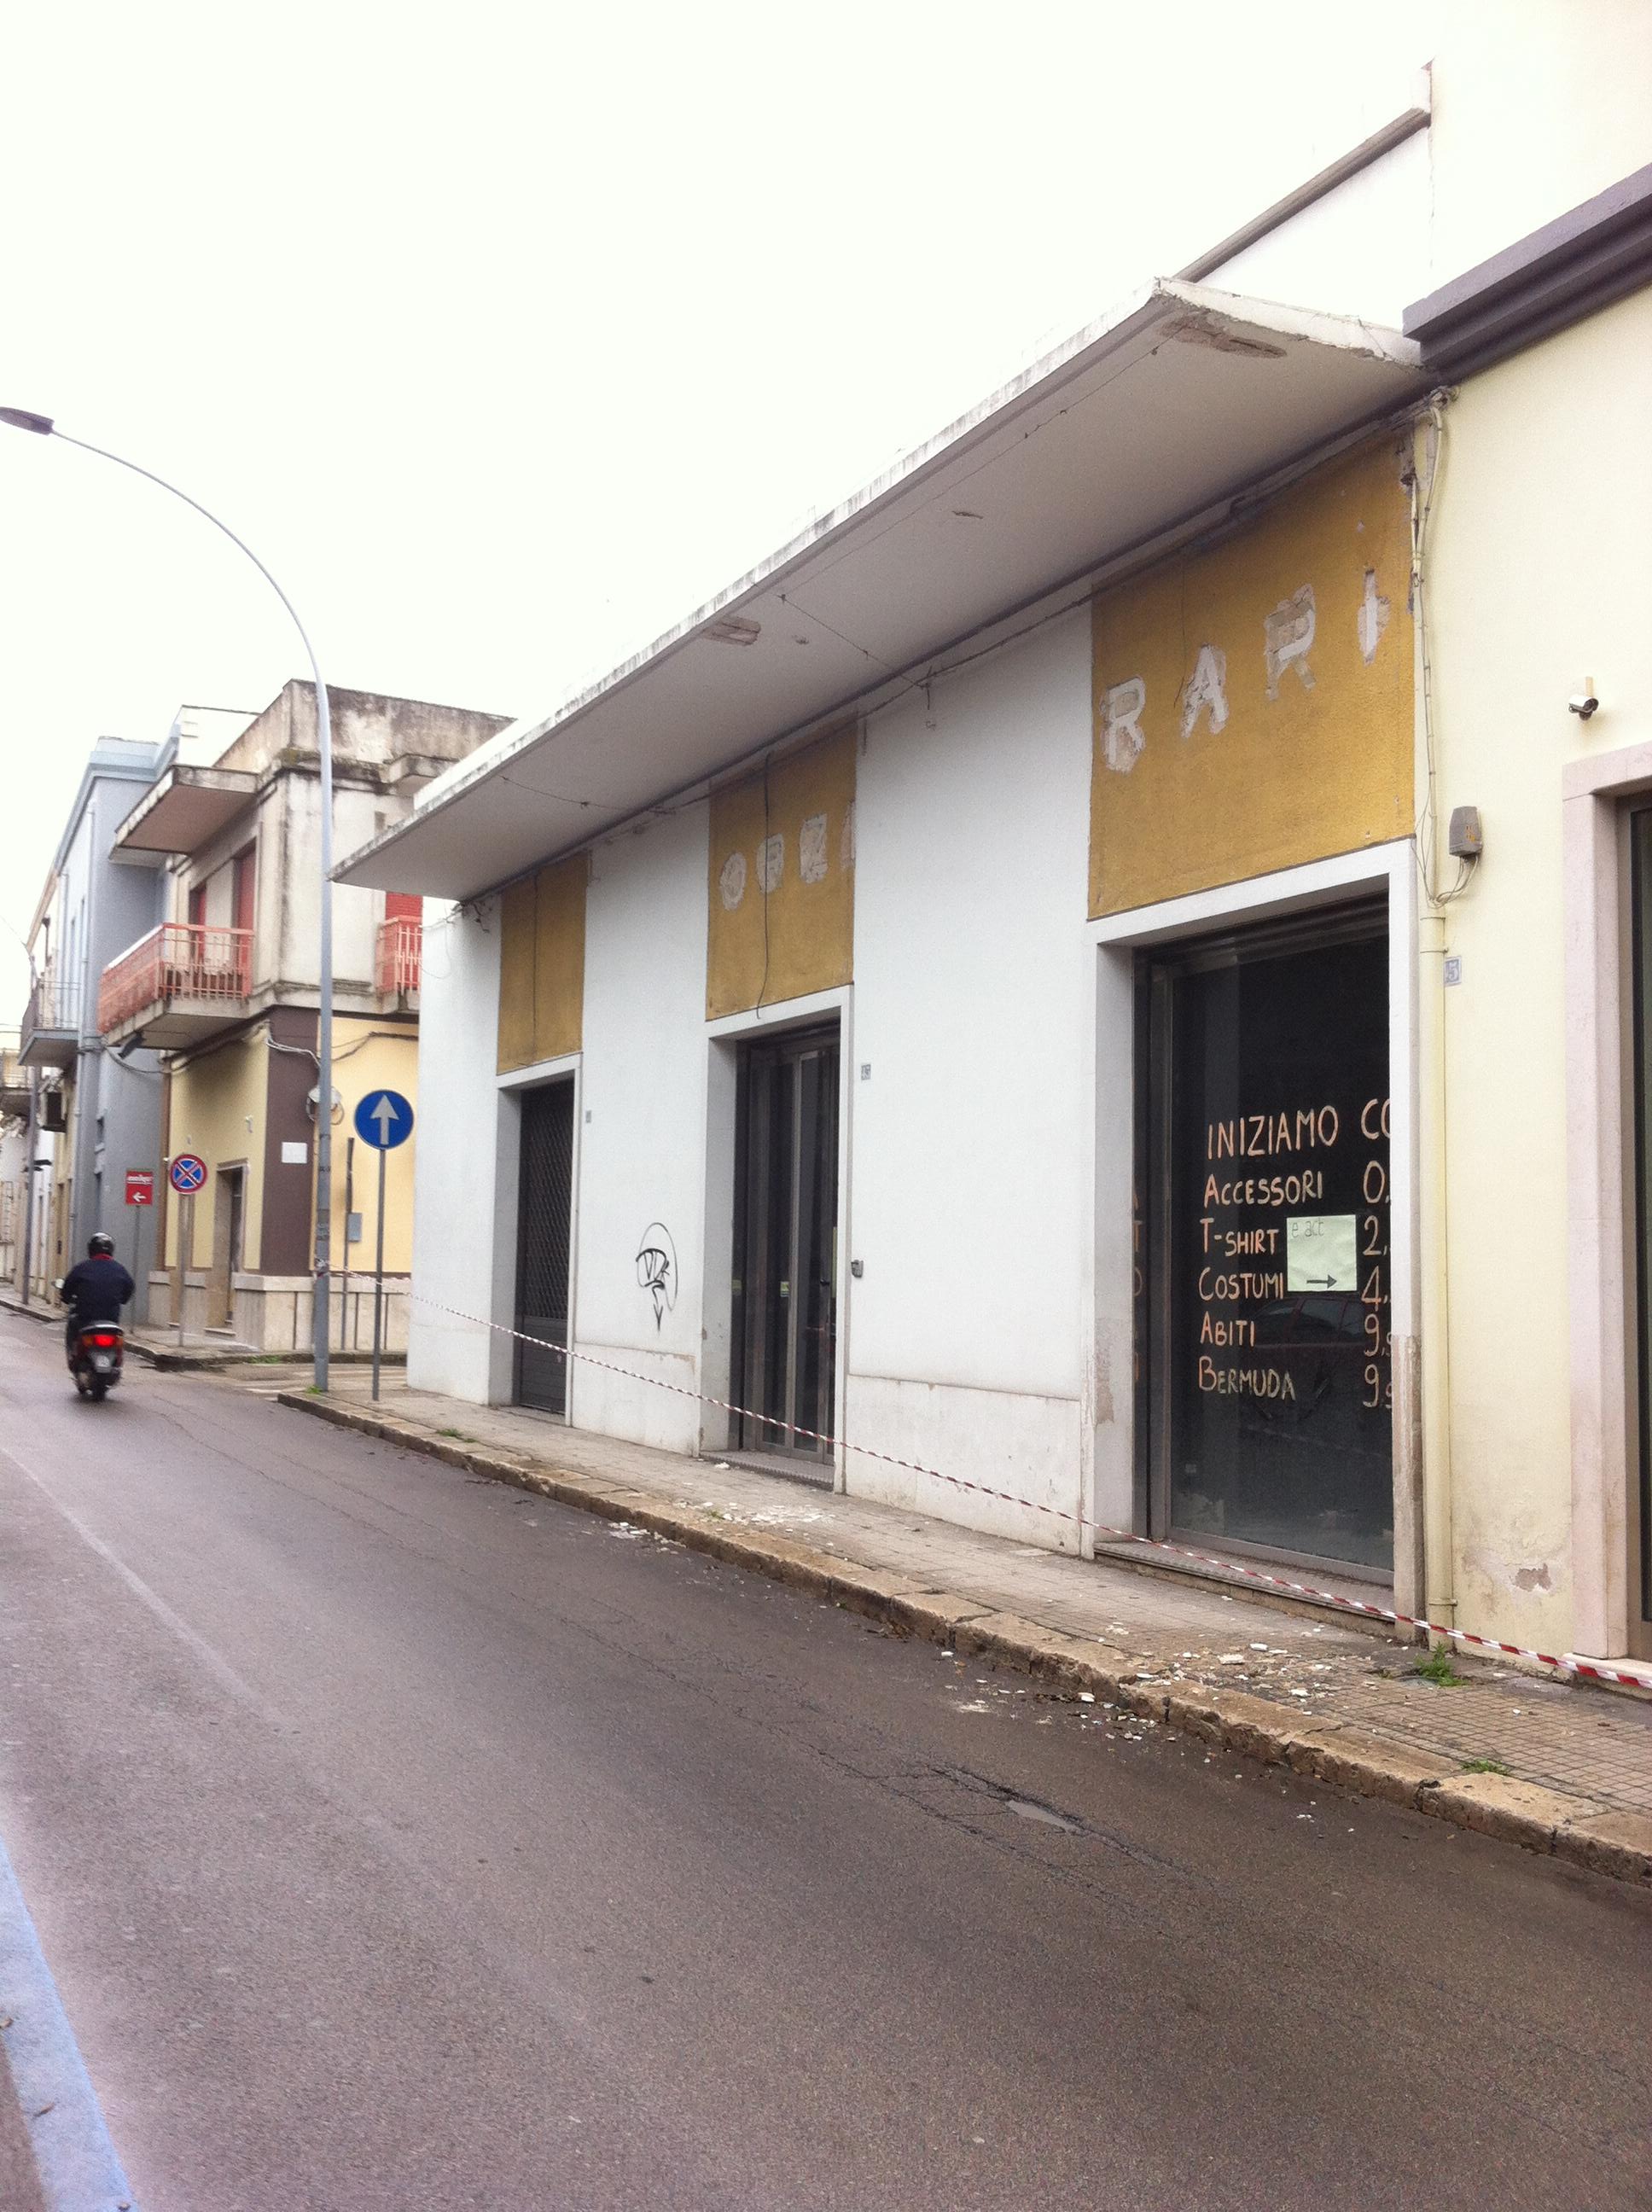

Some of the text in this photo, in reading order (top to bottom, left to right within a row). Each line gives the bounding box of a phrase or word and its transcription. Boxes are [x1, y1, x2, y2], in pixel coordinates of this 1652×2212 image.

[1207, 1105, 1339, 1160] INIZIAMO
[1203, 1169, 1323, 1208] ACCESSORI
[1200, 1218, 1279, 1257] T-SHIRT
[1199, 1267, 1284, 1301] COSTUMI
[1200, 1311, 1255, 1348] ABITI
[1199, 1355, 1297, 1401] BERMUDA
